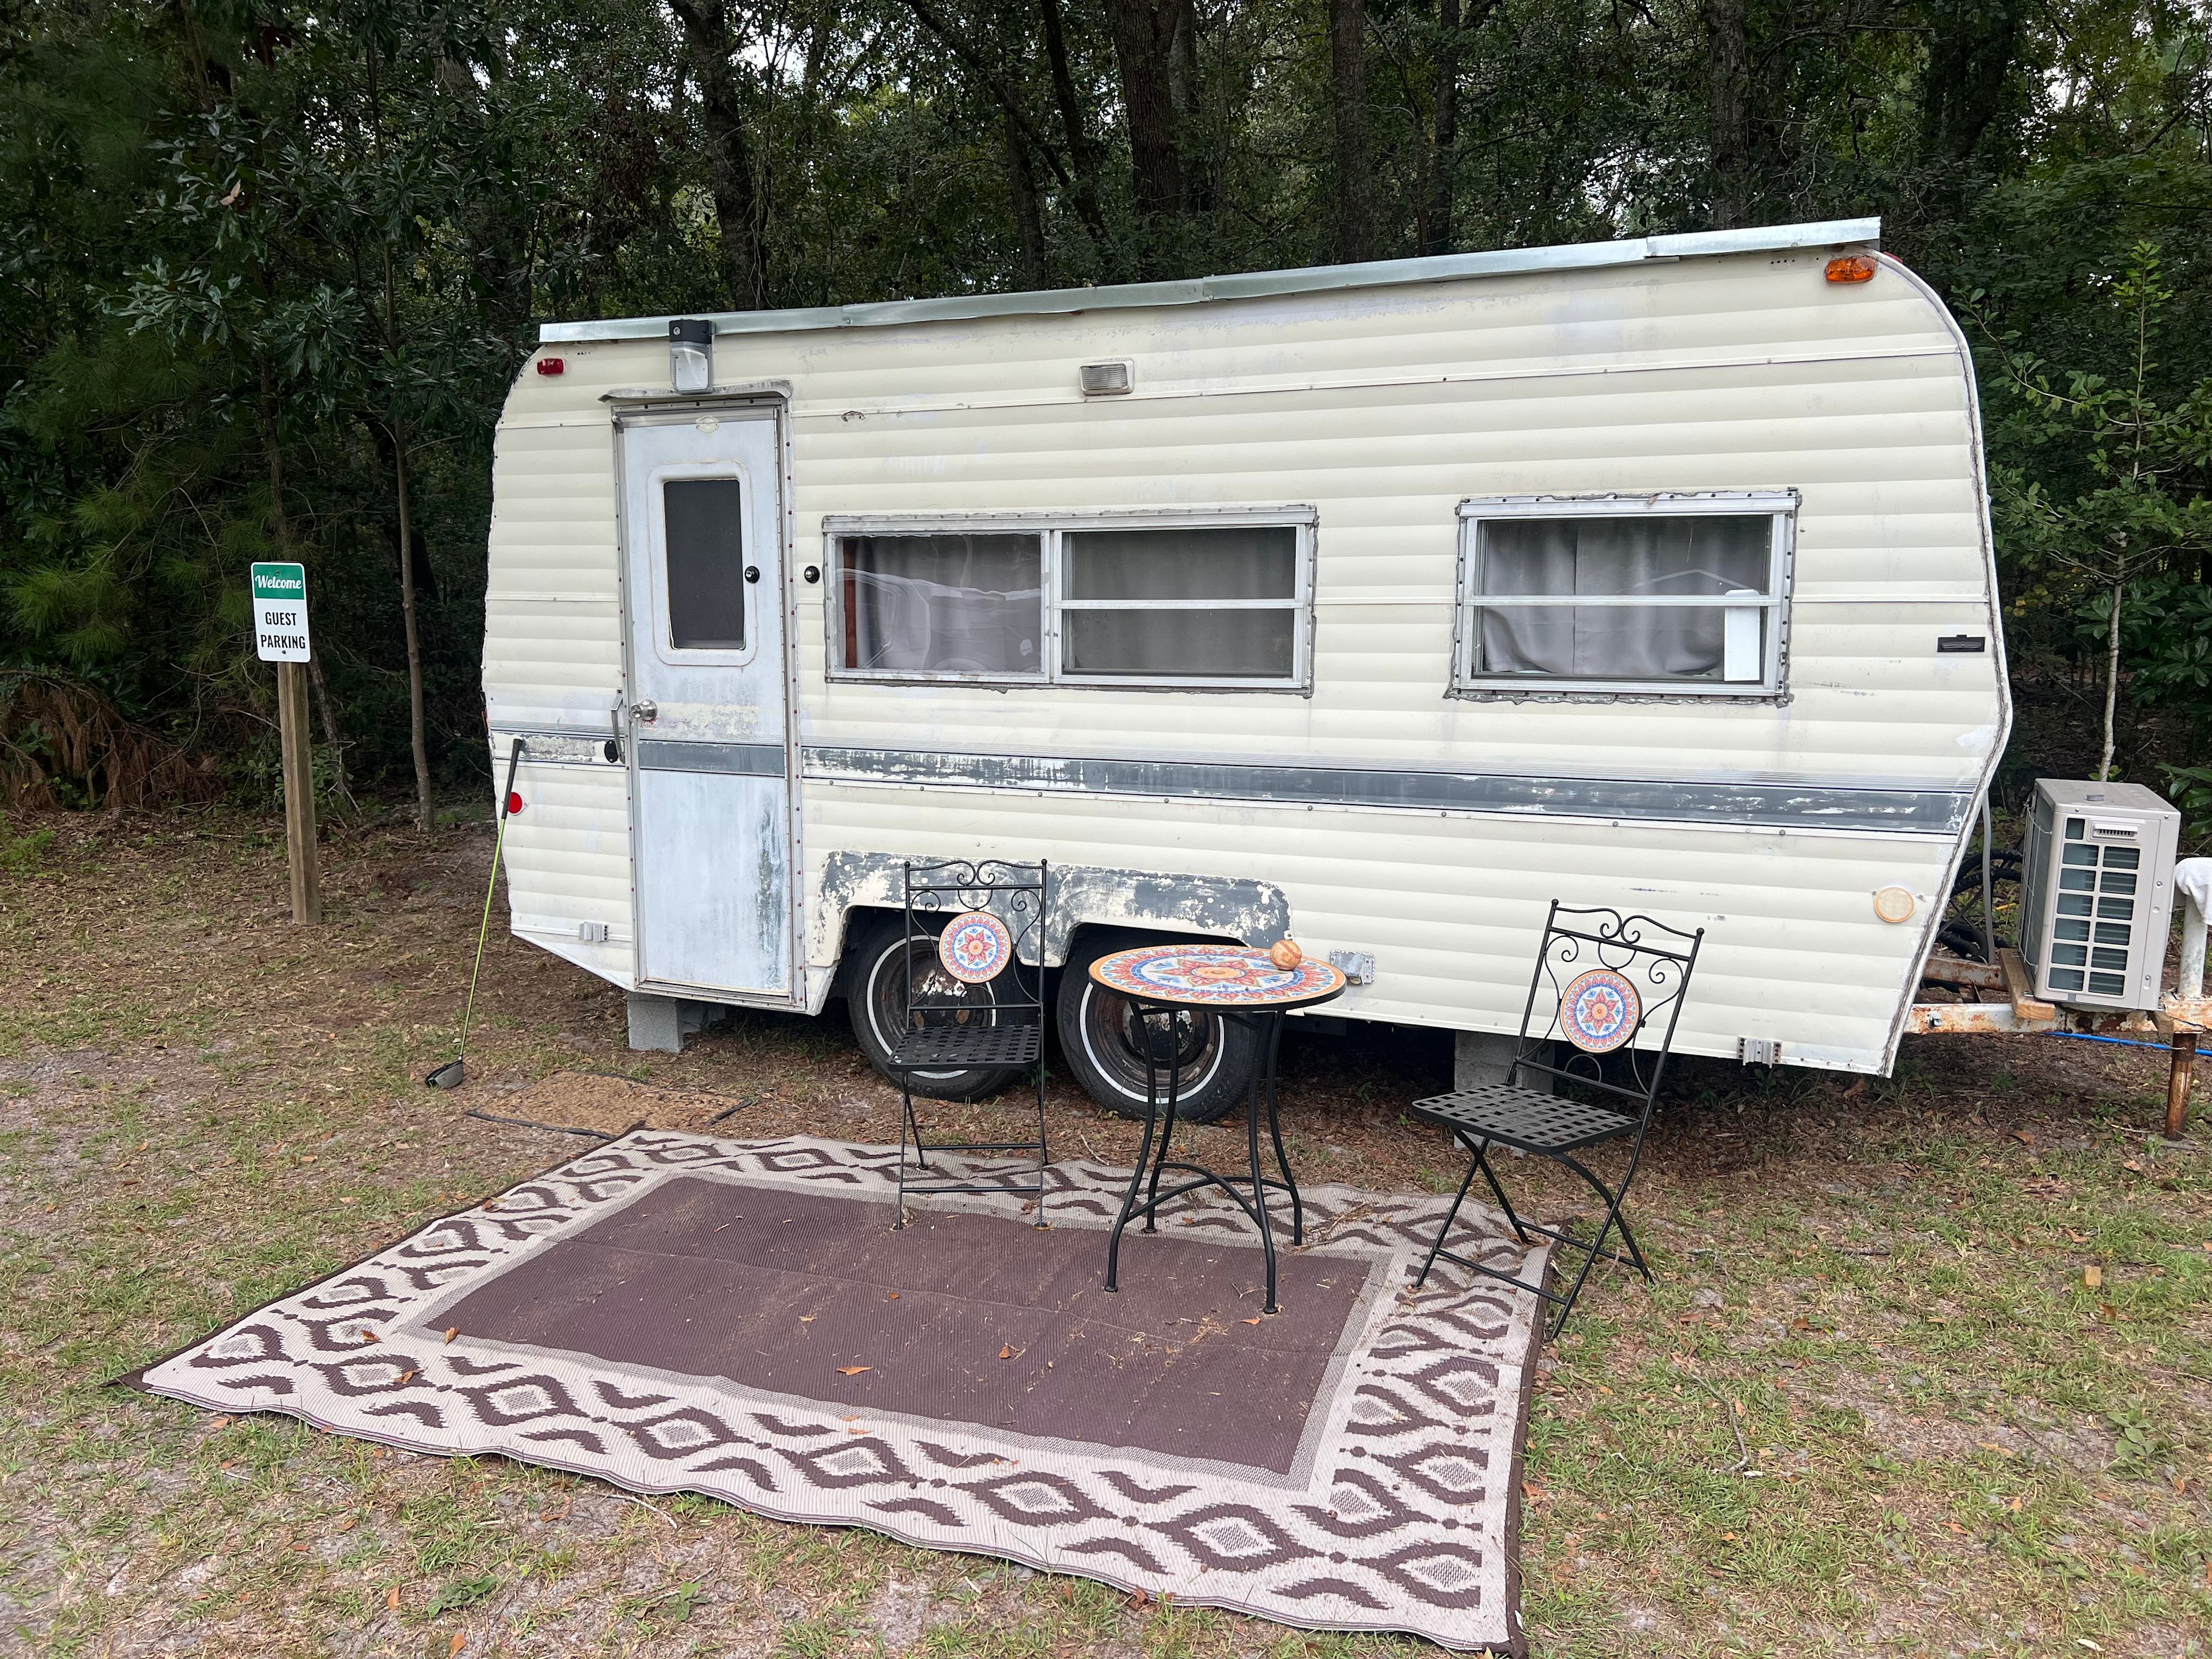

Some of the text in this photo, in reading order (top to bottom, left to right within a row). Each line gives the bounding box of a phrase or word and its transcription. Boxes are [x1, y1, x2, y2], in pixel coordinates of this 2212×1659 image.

[255, 575, 302, 589] Welcome
[265, 612, 297, 626] GUEST
[260, 634, 305, 649] PARKING
